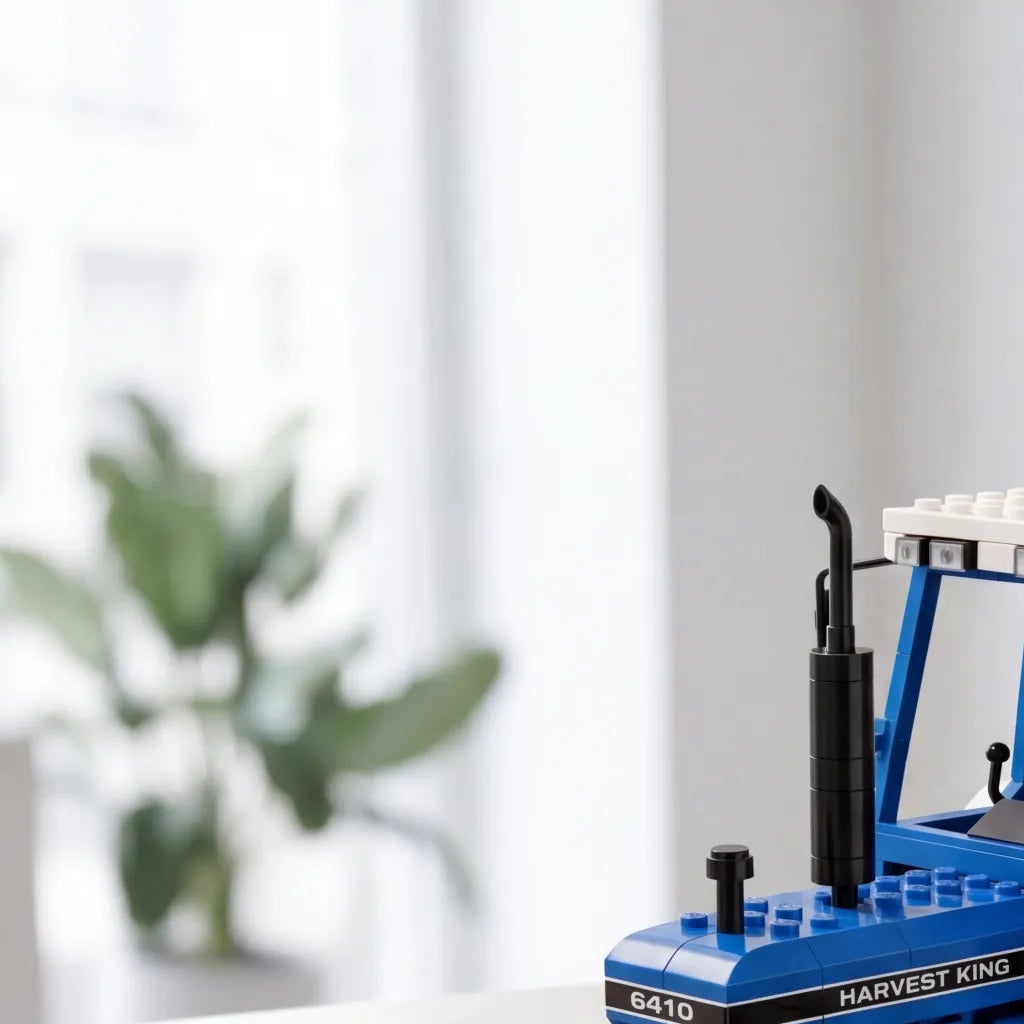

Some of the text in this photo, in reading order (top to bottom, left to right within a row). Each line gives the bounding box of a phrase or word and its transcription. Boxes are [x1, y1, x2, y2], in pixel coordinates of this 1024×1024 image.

[840, 958, 1011, 1007] HARVEST KING
[630, 991, 694, 1022] 6410
